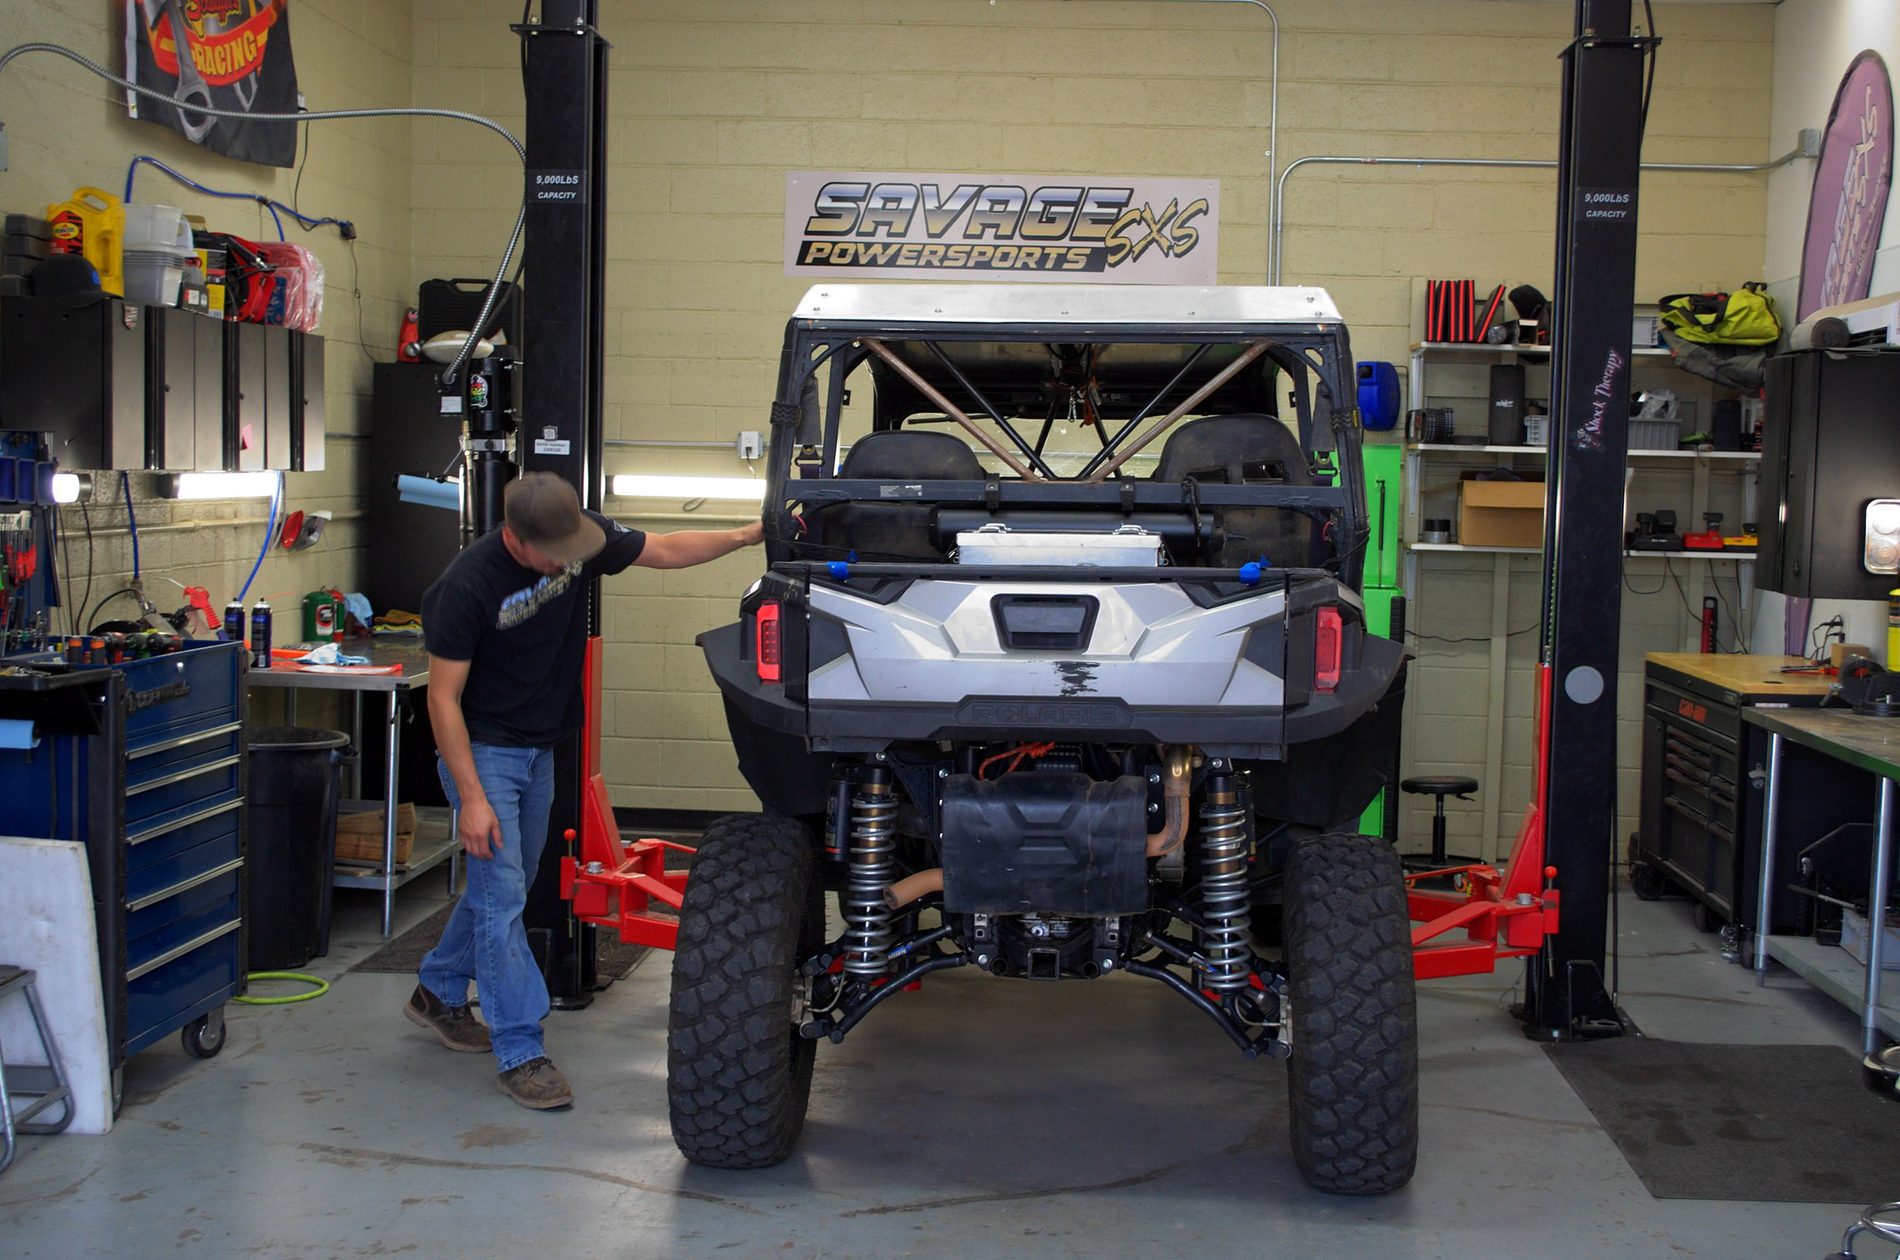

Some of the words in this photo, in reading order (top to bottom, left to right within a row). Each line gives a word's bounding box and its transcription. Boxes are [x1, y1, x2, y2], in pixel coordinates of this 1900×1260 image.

[193, 30, 257, 76] RACING
[536, 175, 579, 185] 9,000LbS
[537, 191, 577, 200] CAPACITY
[1584, 193, 1630, 204] 9,000LbS
[804, 181, 1135, 242] SAVAGE
[1585, 210, 1628, 219] CAPACITY
[1103, 197, 1209, 269] SXS
[804, 241, 1093, 270] POWERSPORTS
[1594, 348, 1623, 398] Therapy
[971, 704, 1117, 724] POLARIS
